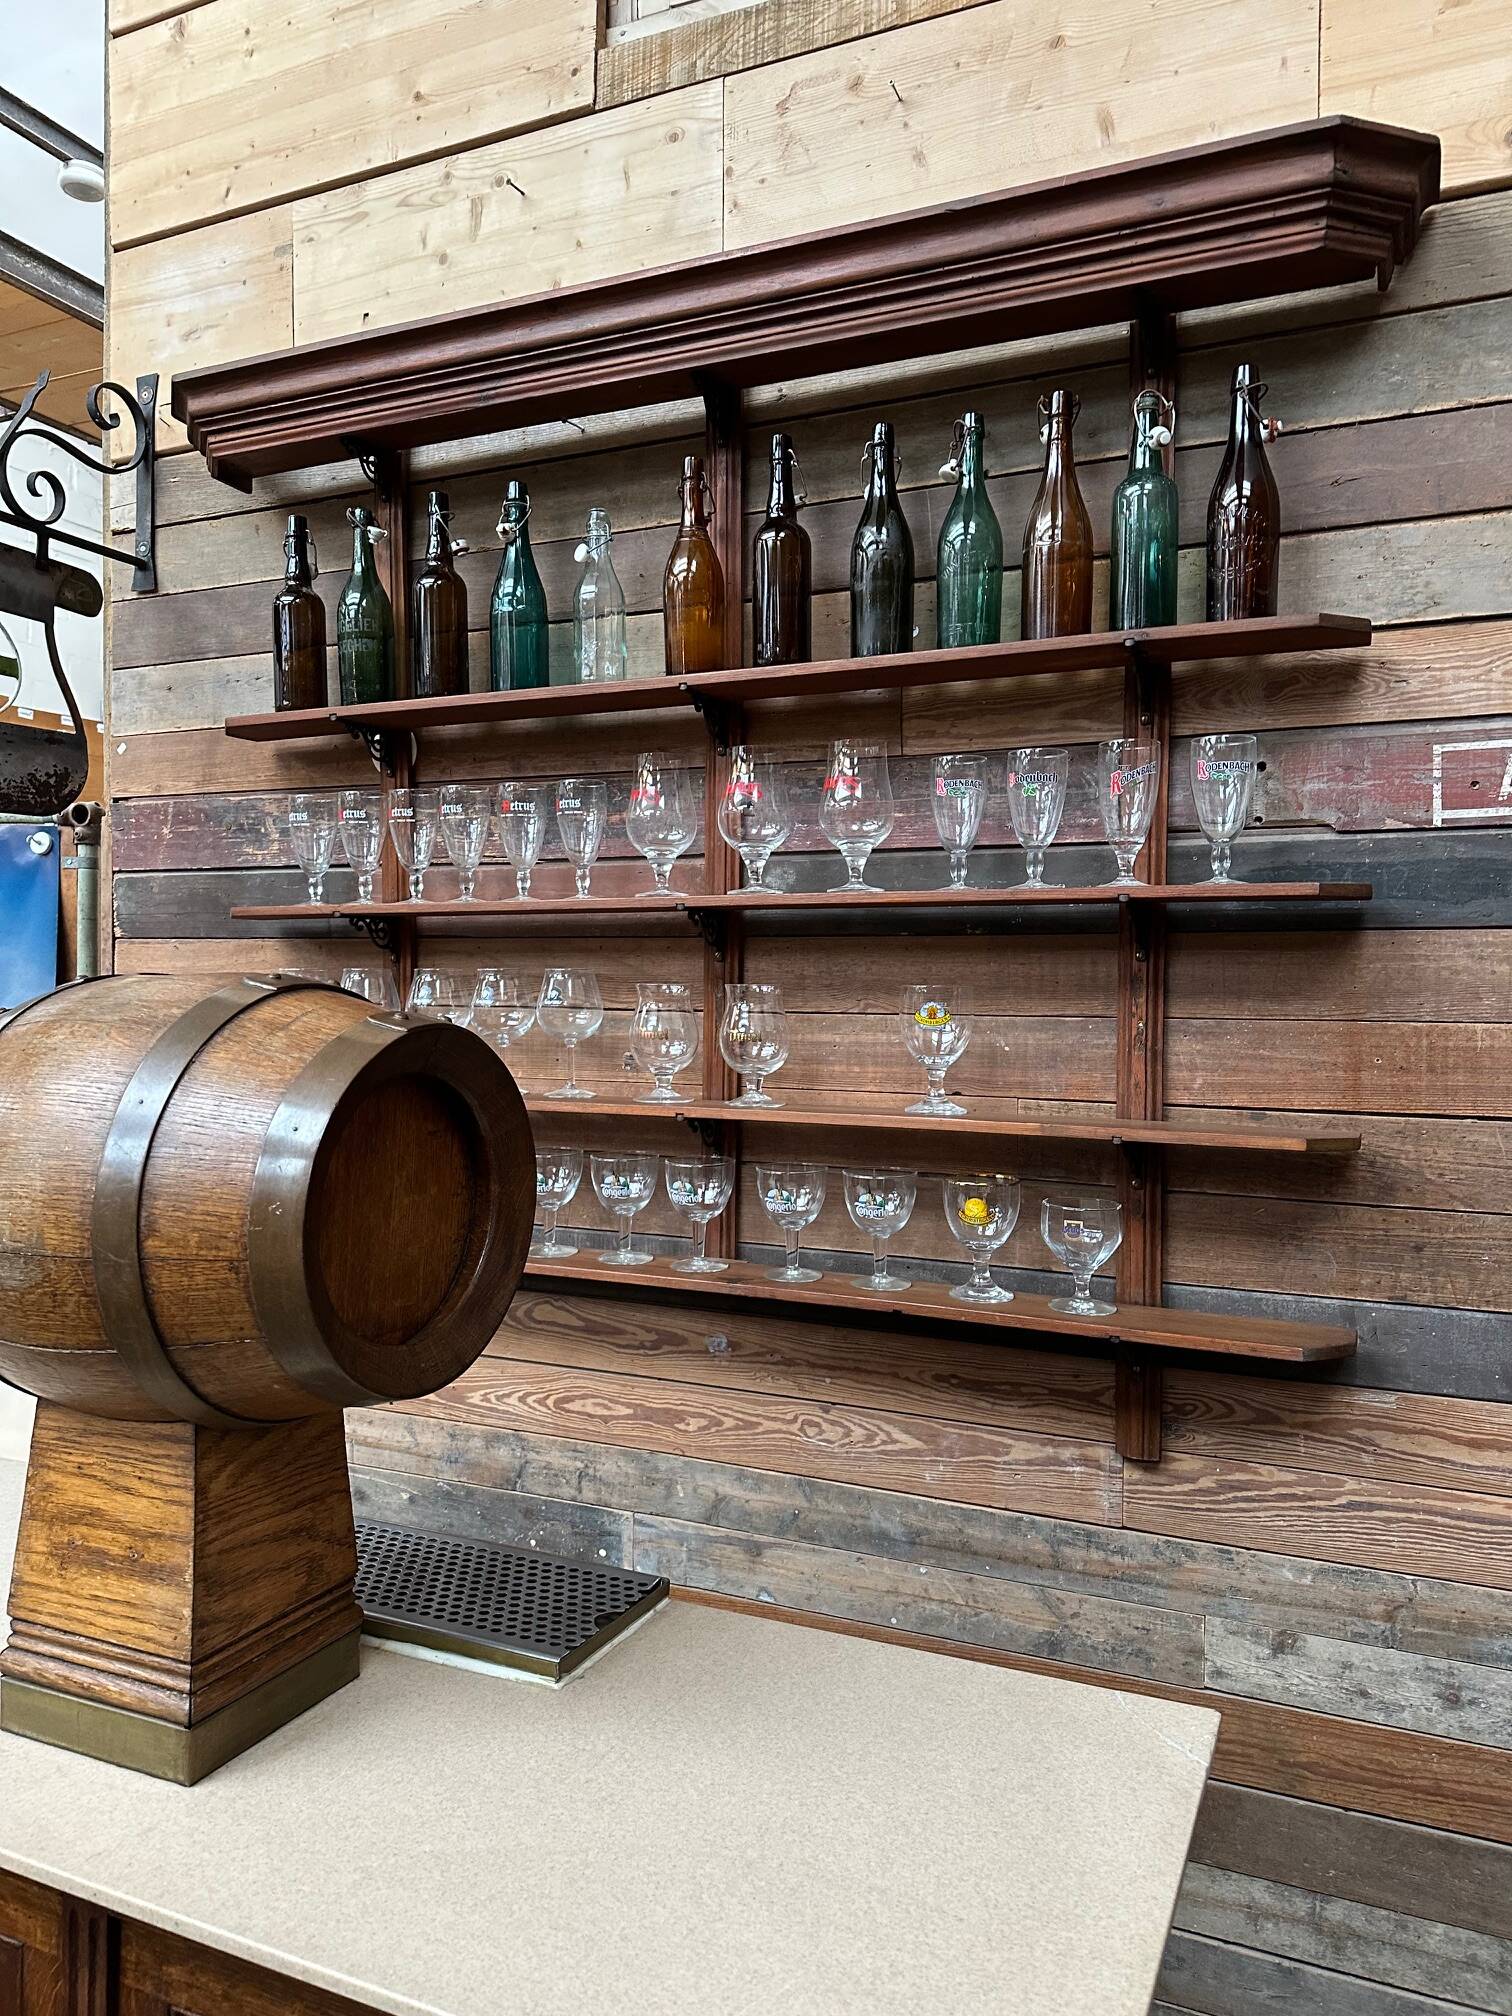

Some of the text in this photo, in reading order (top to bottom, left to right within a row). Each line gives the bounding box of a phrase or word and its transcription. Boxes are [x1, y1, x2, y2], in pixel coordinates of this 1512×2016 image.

[1197, 760, 1251, 780] RODENBACH
[338, 808, 367, 821] etrus
[388, 806, 414, 818] etrus
[439, 803, 463, 814] etrus
[289, 811, 308, 821] etrus
